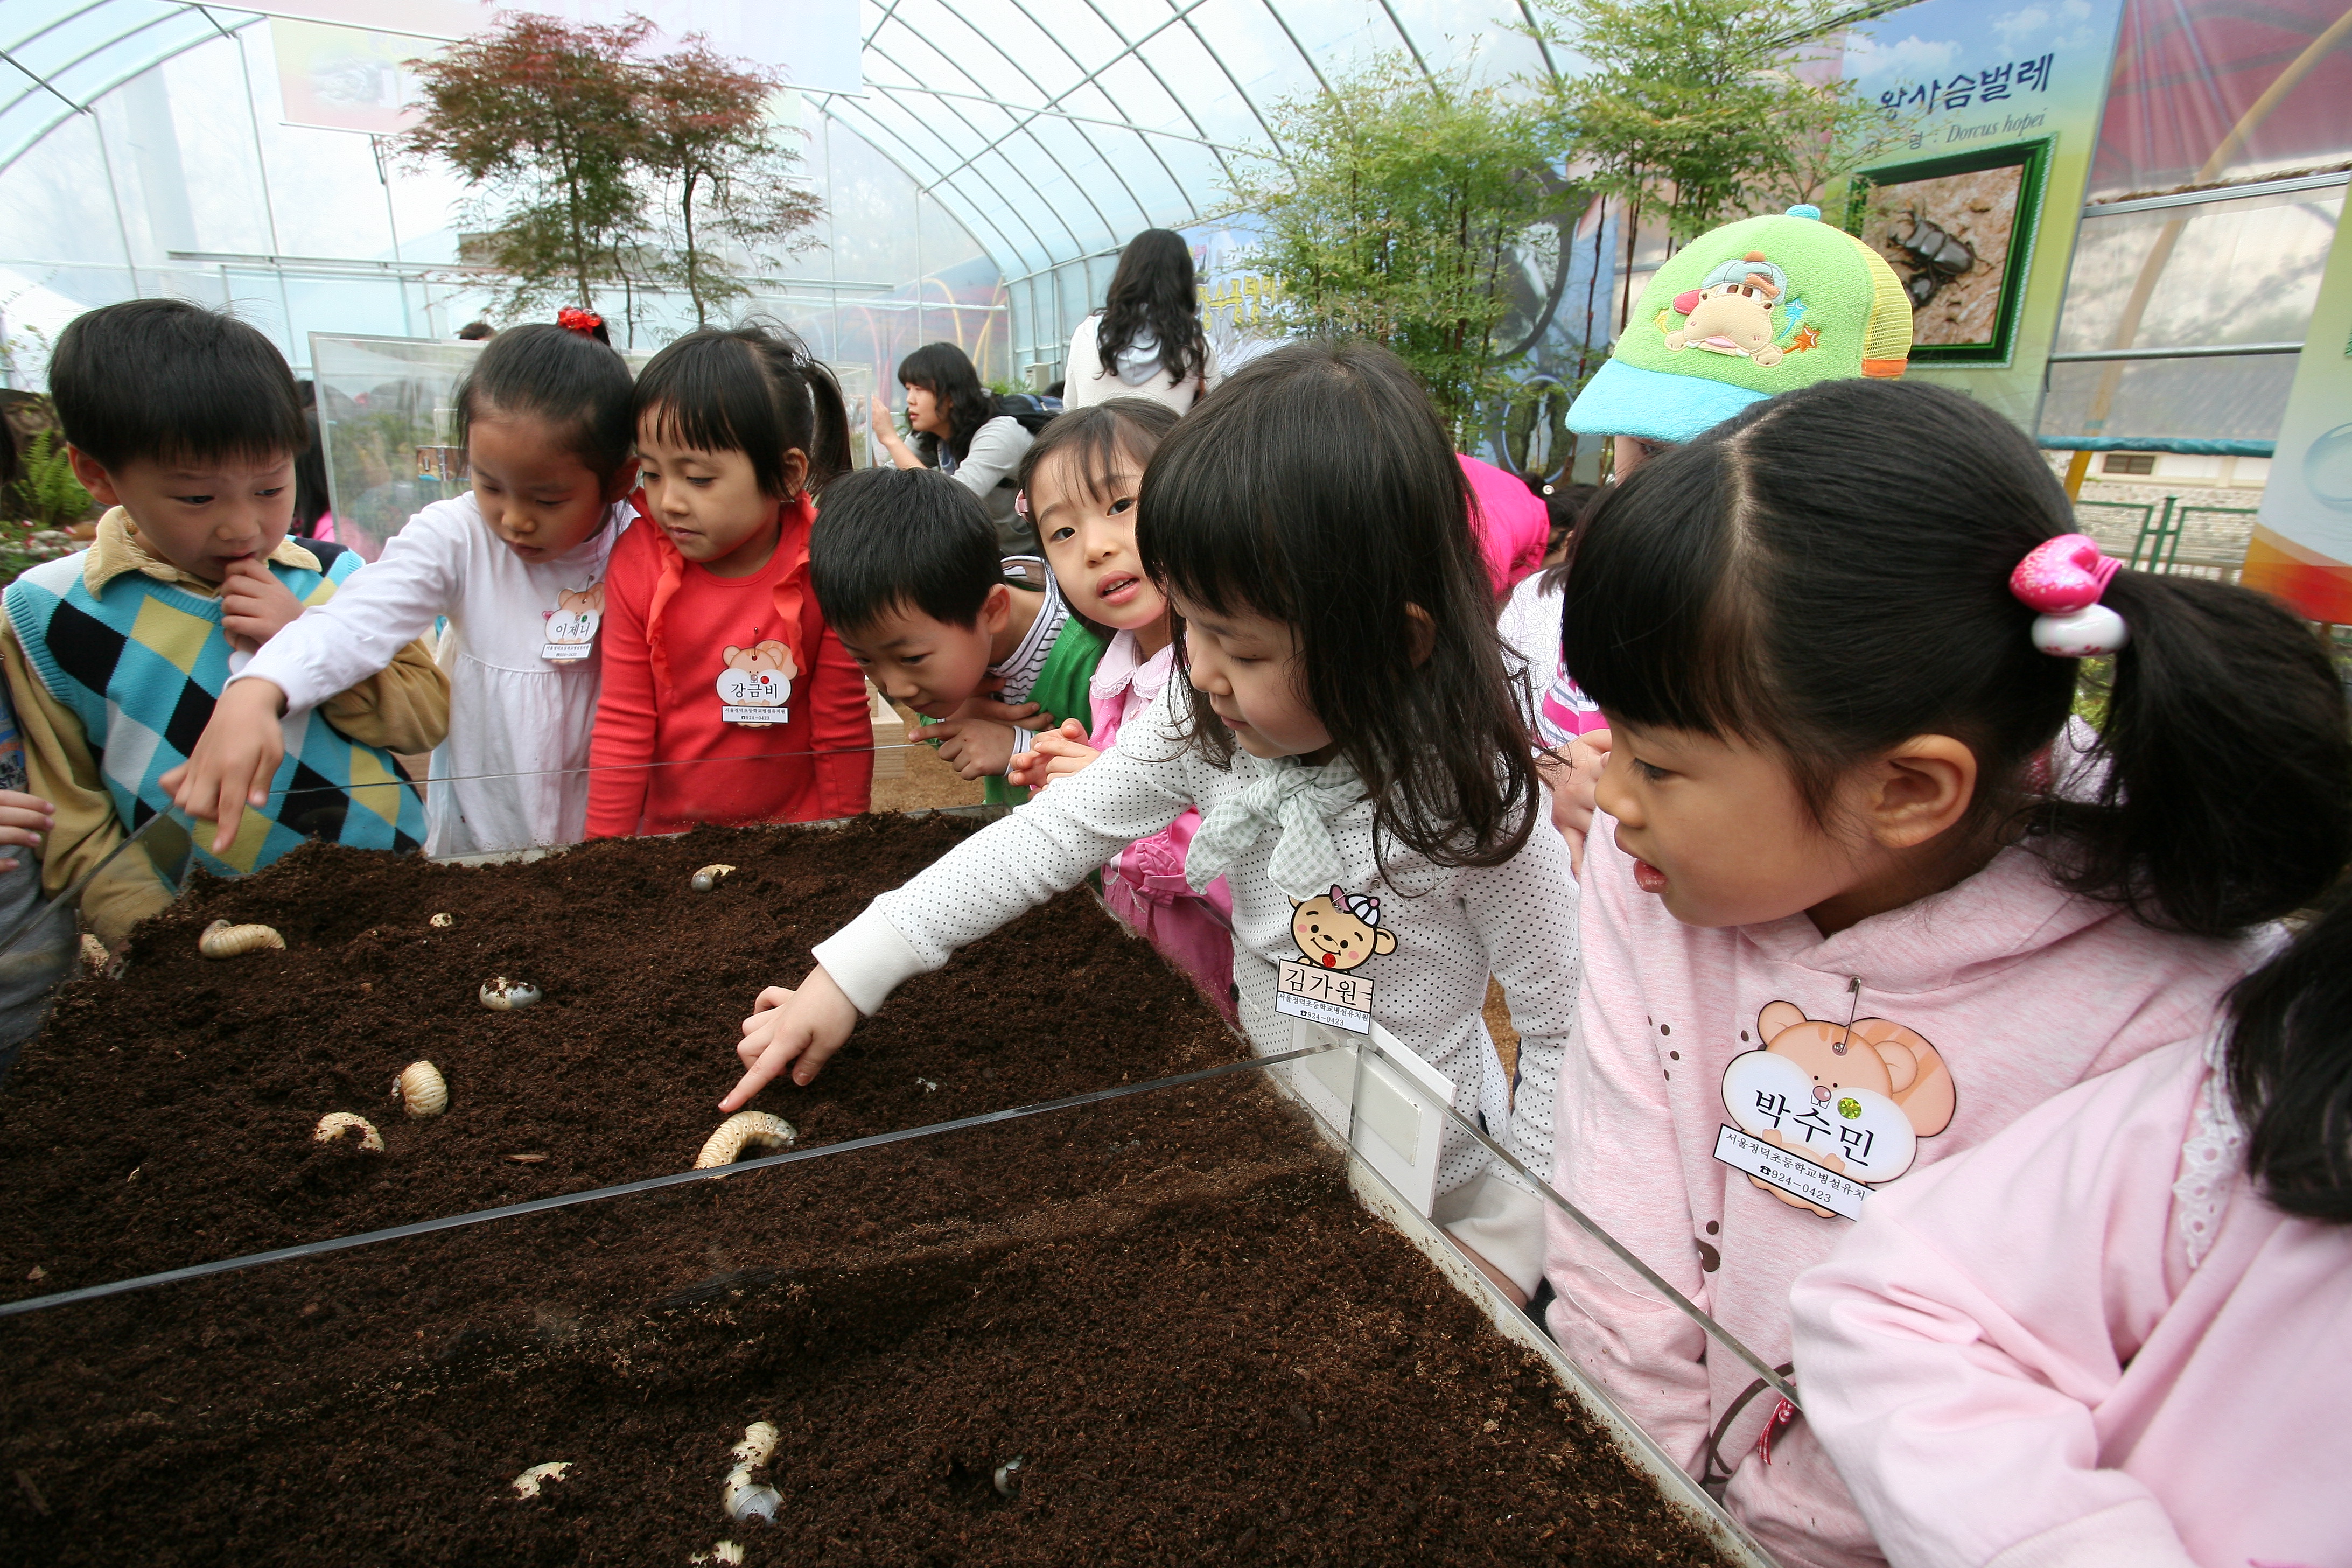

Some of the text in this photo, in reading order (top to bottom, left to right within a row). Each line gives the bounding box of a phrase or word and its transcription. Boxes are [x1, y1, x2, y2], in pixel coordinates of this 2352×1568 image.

[1875, 53, 2054, 121] 왕사슴벌레
[1945, 121, 1998, 143] Dorcus
[2002, 107, 2048, 137] hopei
[556, 622, 590, 638] 이제니
[731, 682, 777, 699] 강금비
[1285, 968, 1356, 1006] 김가원
[1278, 993, 1369, 1022] 서울정덕초등학교병설유치원
[1755, 1090, 1874, 1167] 박수민
